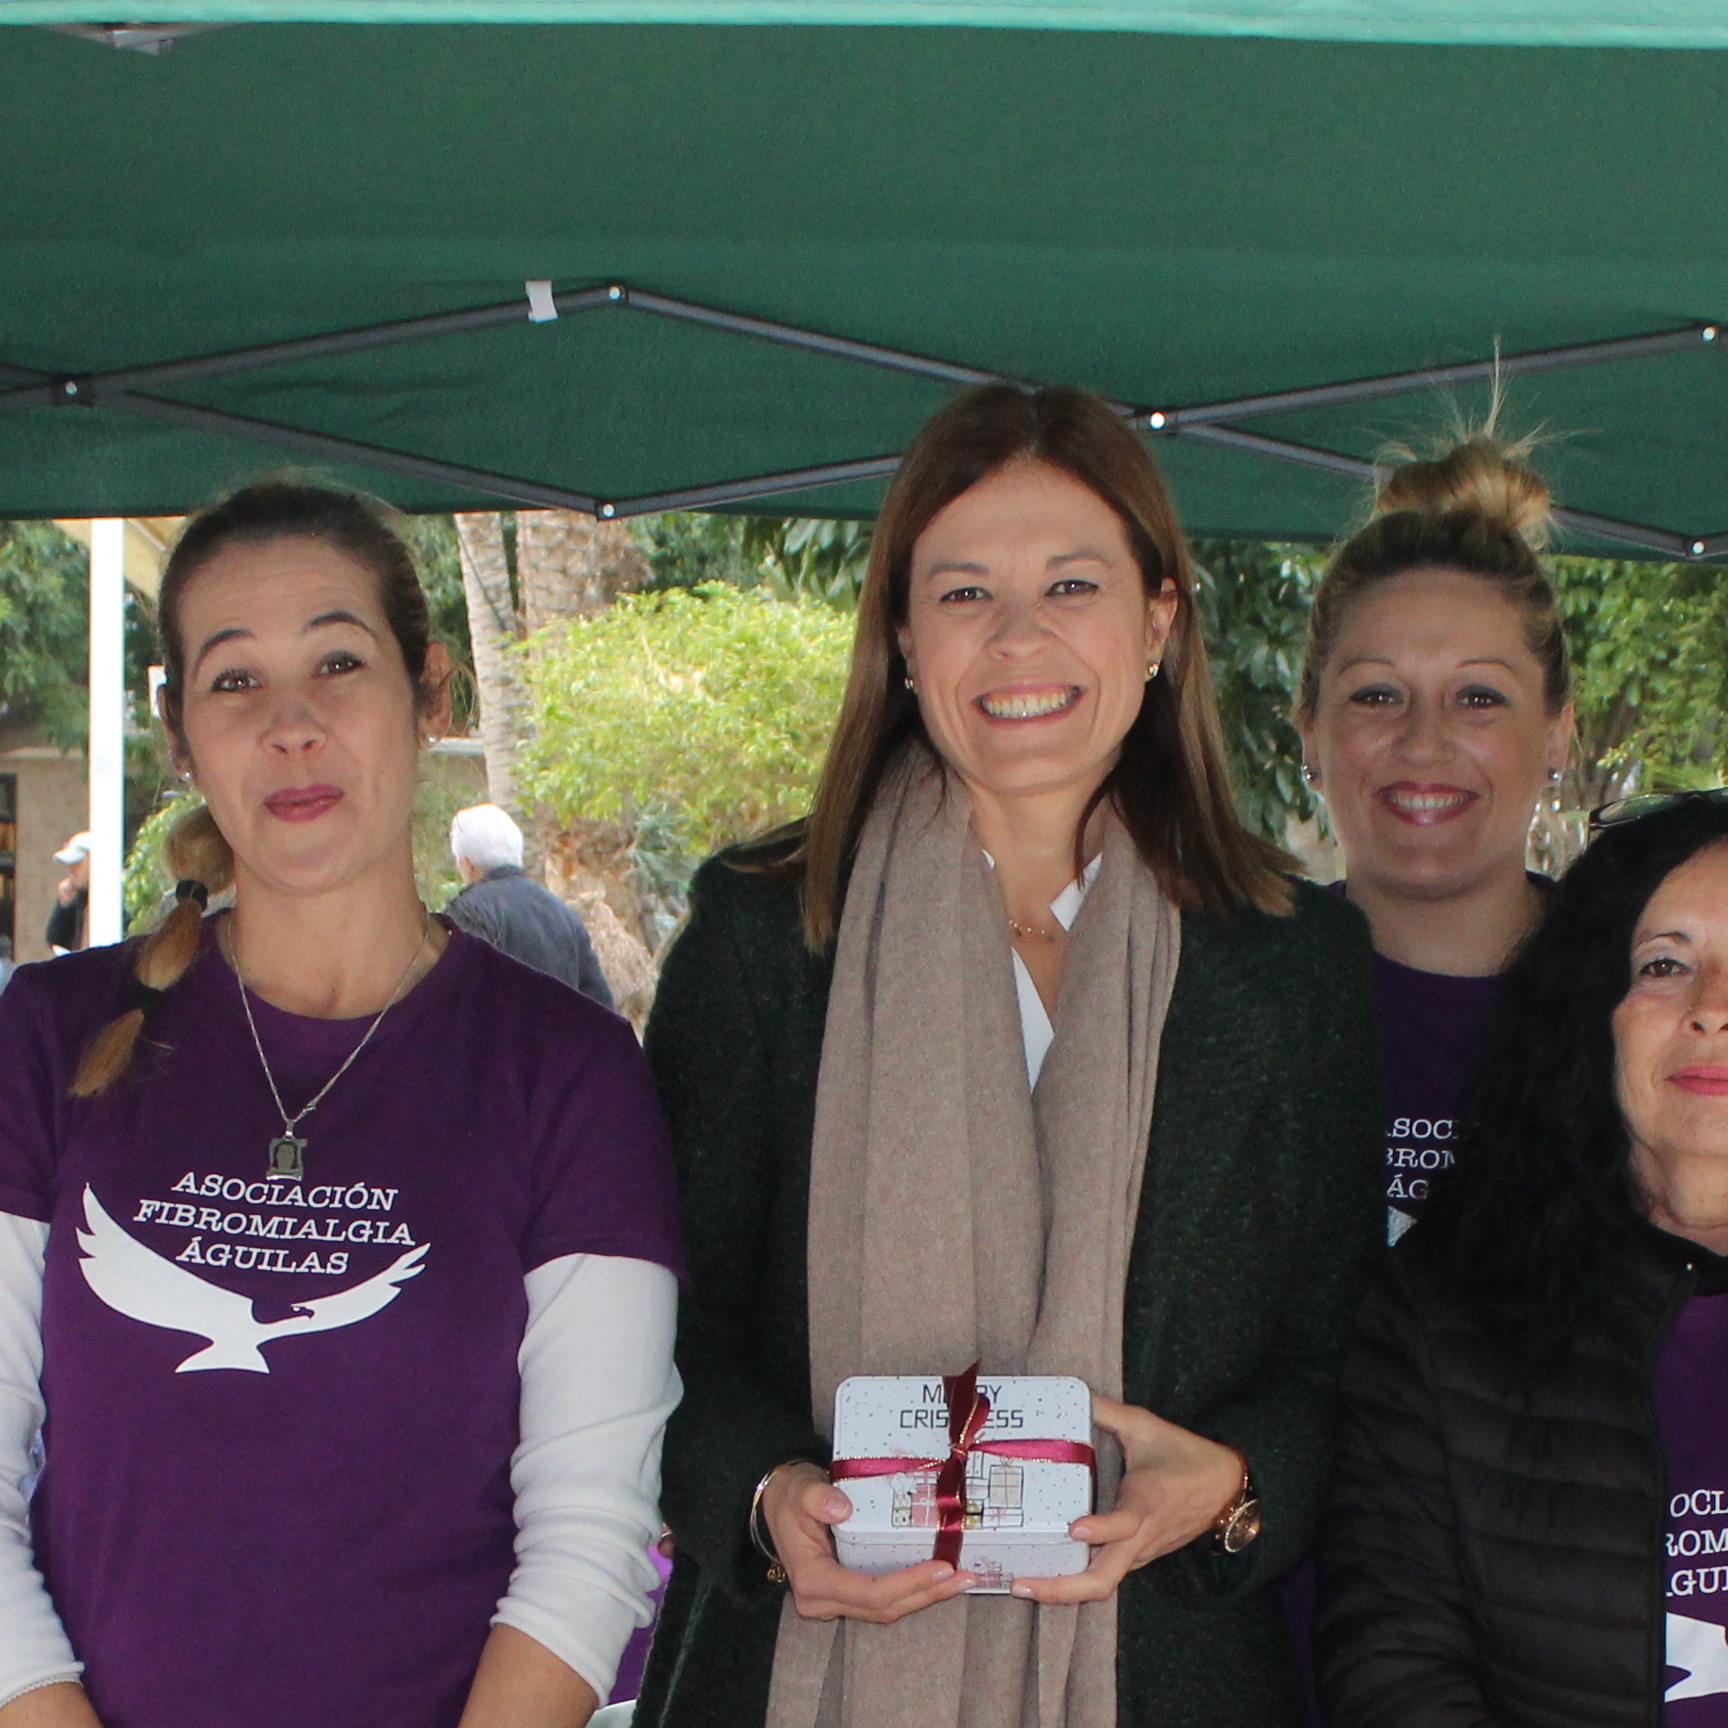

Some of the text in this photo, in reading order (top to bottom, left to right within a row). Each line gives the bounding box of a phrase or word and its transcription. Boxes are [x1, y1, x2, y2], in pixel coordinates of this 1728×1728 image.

[171, 1171, 399, 1212] ASOCIACIÓN
[132, 1199, 417, 1247] FIBROMIALGIA
[174, 1236, 350, 1275] ÁGUILAS
